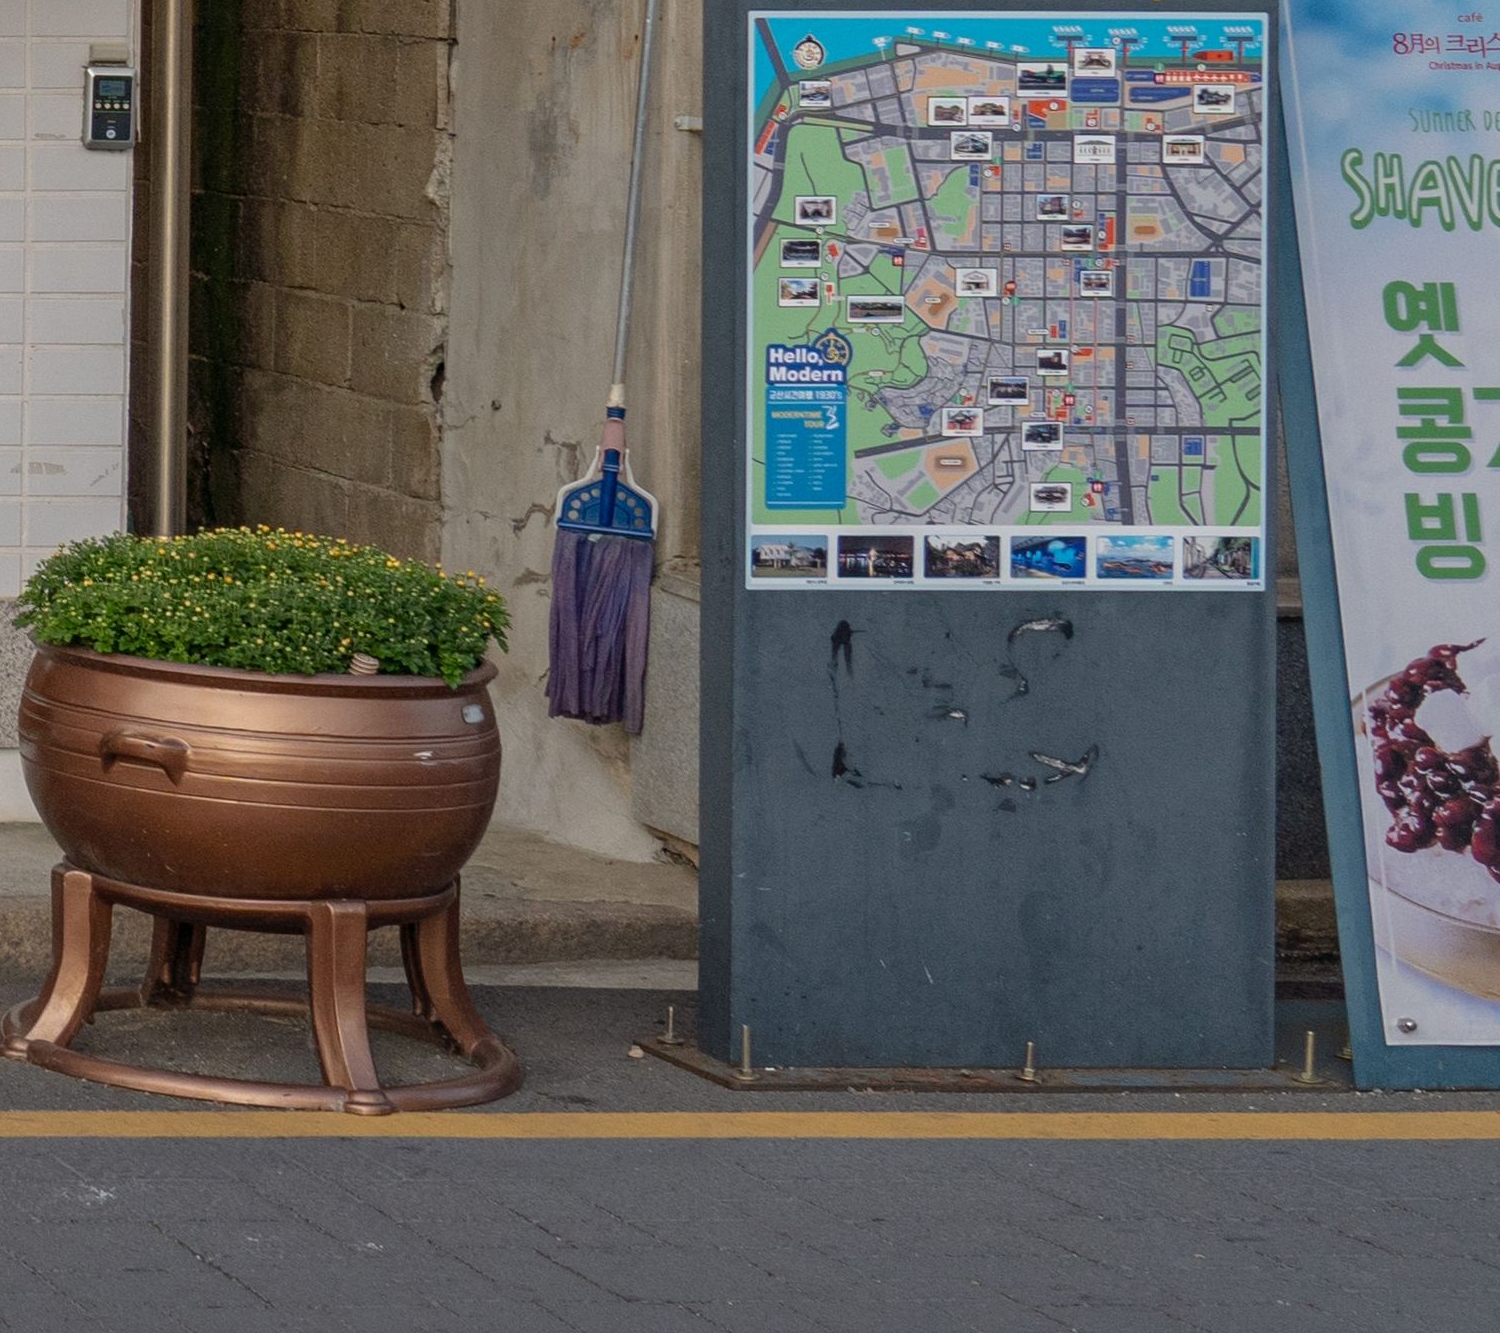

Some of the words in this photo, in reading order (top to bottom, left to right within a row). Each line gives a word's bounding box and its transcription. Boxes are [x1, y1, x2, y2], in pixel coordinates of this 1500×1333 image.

[1393, 32, 1441, 56] 8月의
[1429, 61, 1473, 71] Christmas
[1408, 108, 1476, 133] SUMMER
[769, 348, 824, 366] Hello,
[769, 366, 843, 382] Modern
[1403, 491, 1487, 582] 빙
